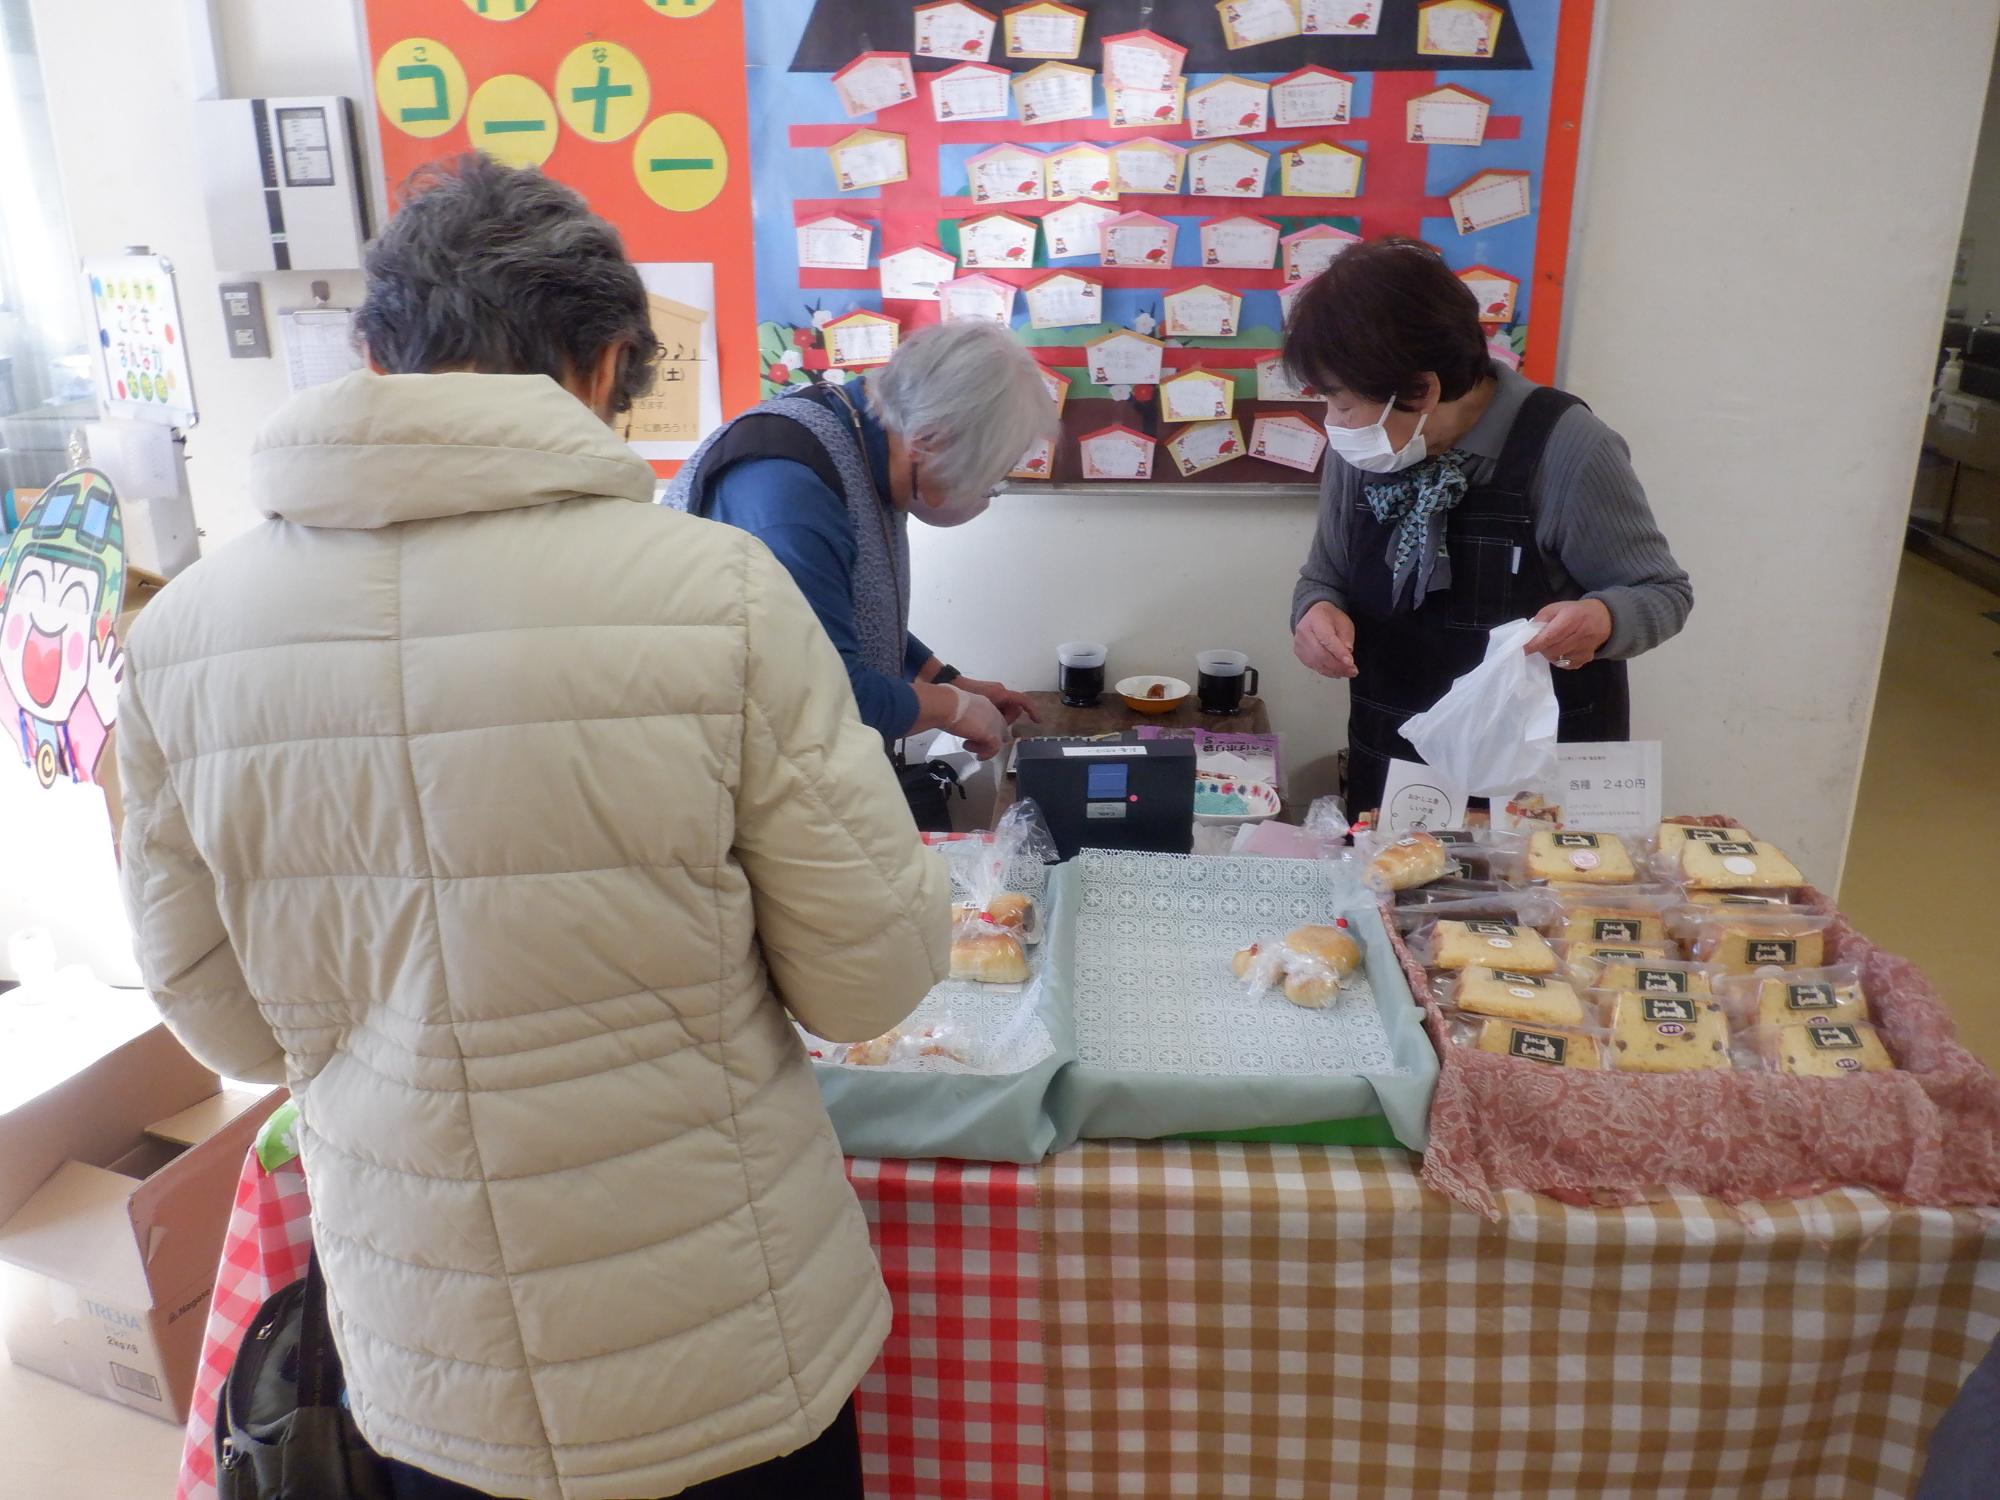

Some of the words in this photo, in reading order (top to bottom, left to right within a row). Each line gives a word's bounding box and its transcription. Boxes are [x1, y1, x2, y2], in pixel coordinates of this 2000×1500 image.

[413, 47, 428, 62] こ
[592, 47, 607, 63] な
[1602, 778, 1646, 790] 240円
